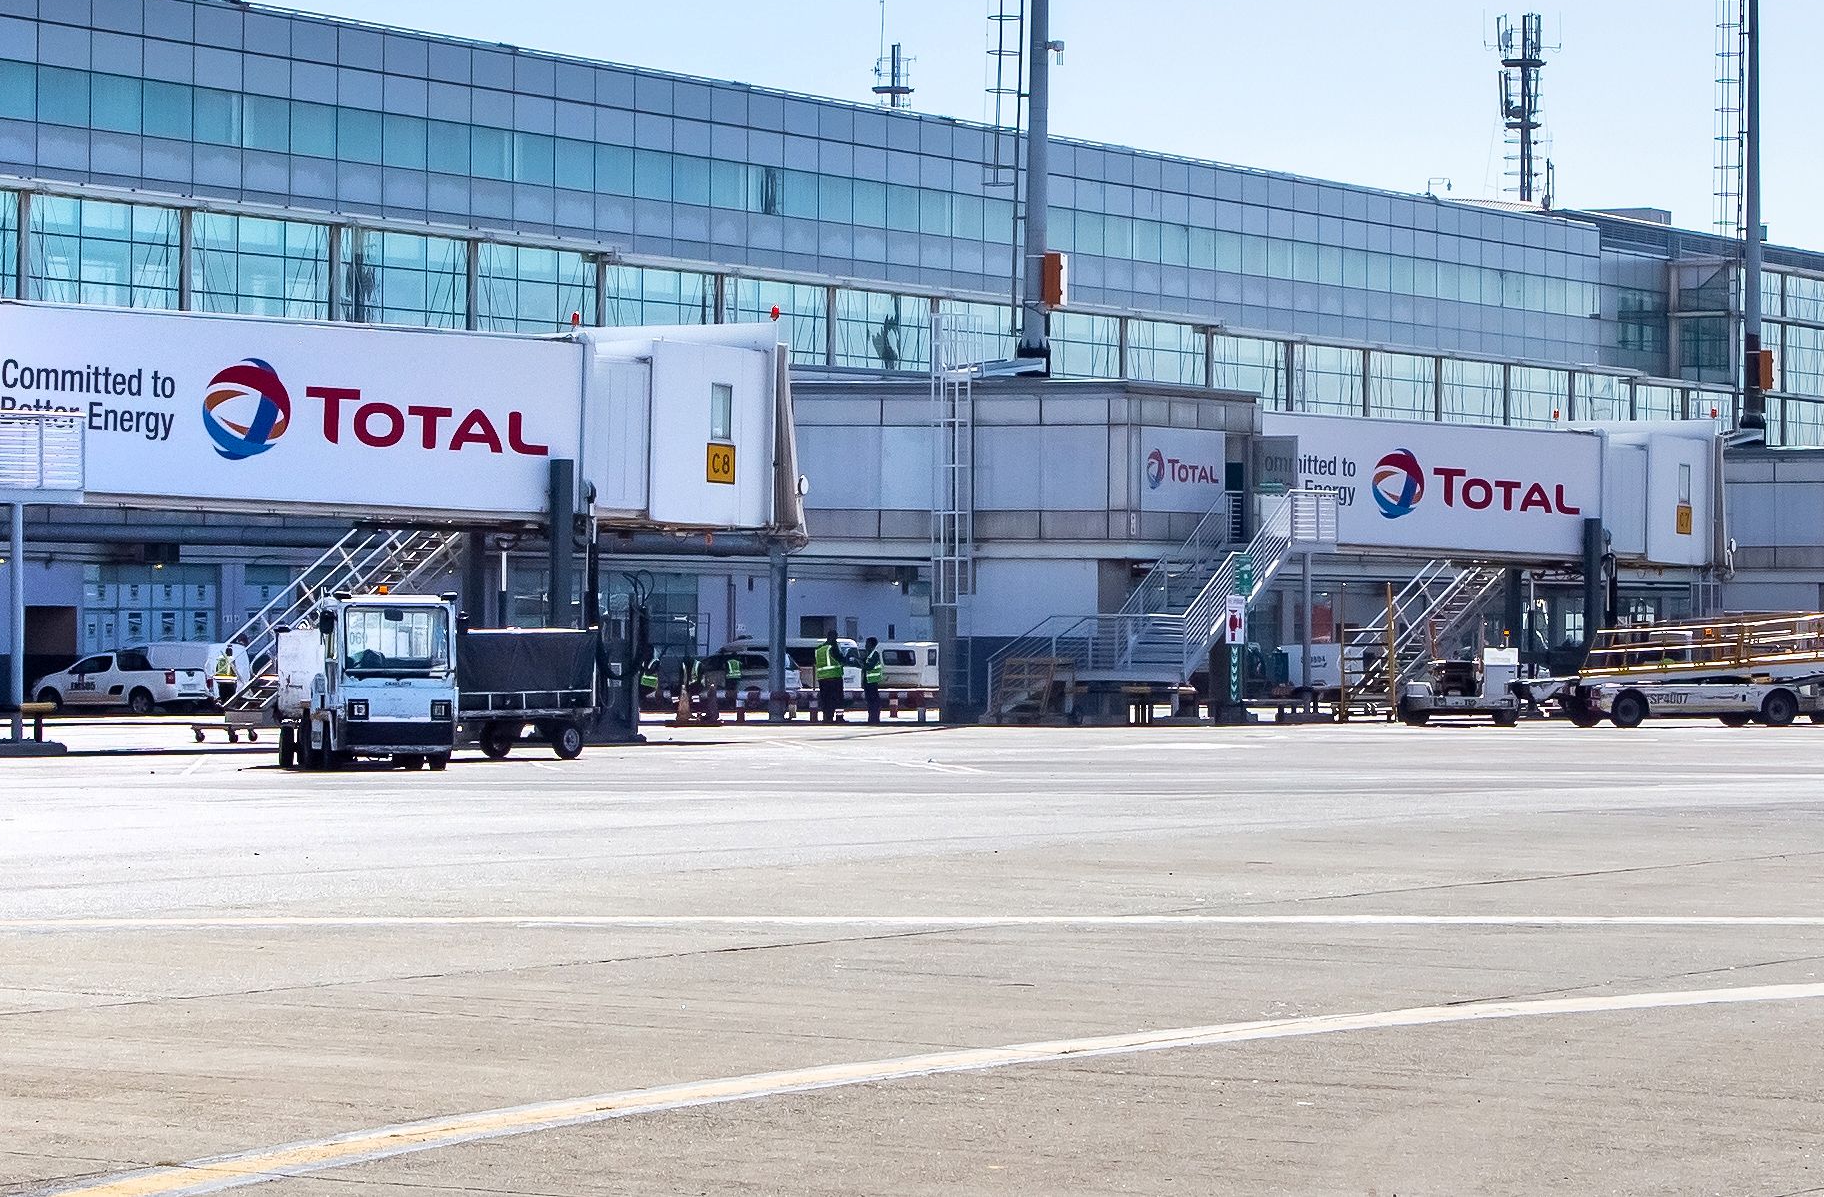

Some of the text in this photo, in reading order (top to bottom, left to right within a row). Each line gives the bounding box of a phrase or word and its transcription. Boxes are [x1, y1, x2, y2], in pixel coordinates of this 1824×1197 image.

[2, 358, 176, 400] Committed to
[87, 401, 175, 441] Energy
[305, 385, 549, 456] TOTAL
[711, 452, 731, 475] C8
[1167, 458, 1219, 484] TOTAL
[1342, 457, 1356, 478] to
[1433, 467, 1581, 515] TOTAL
